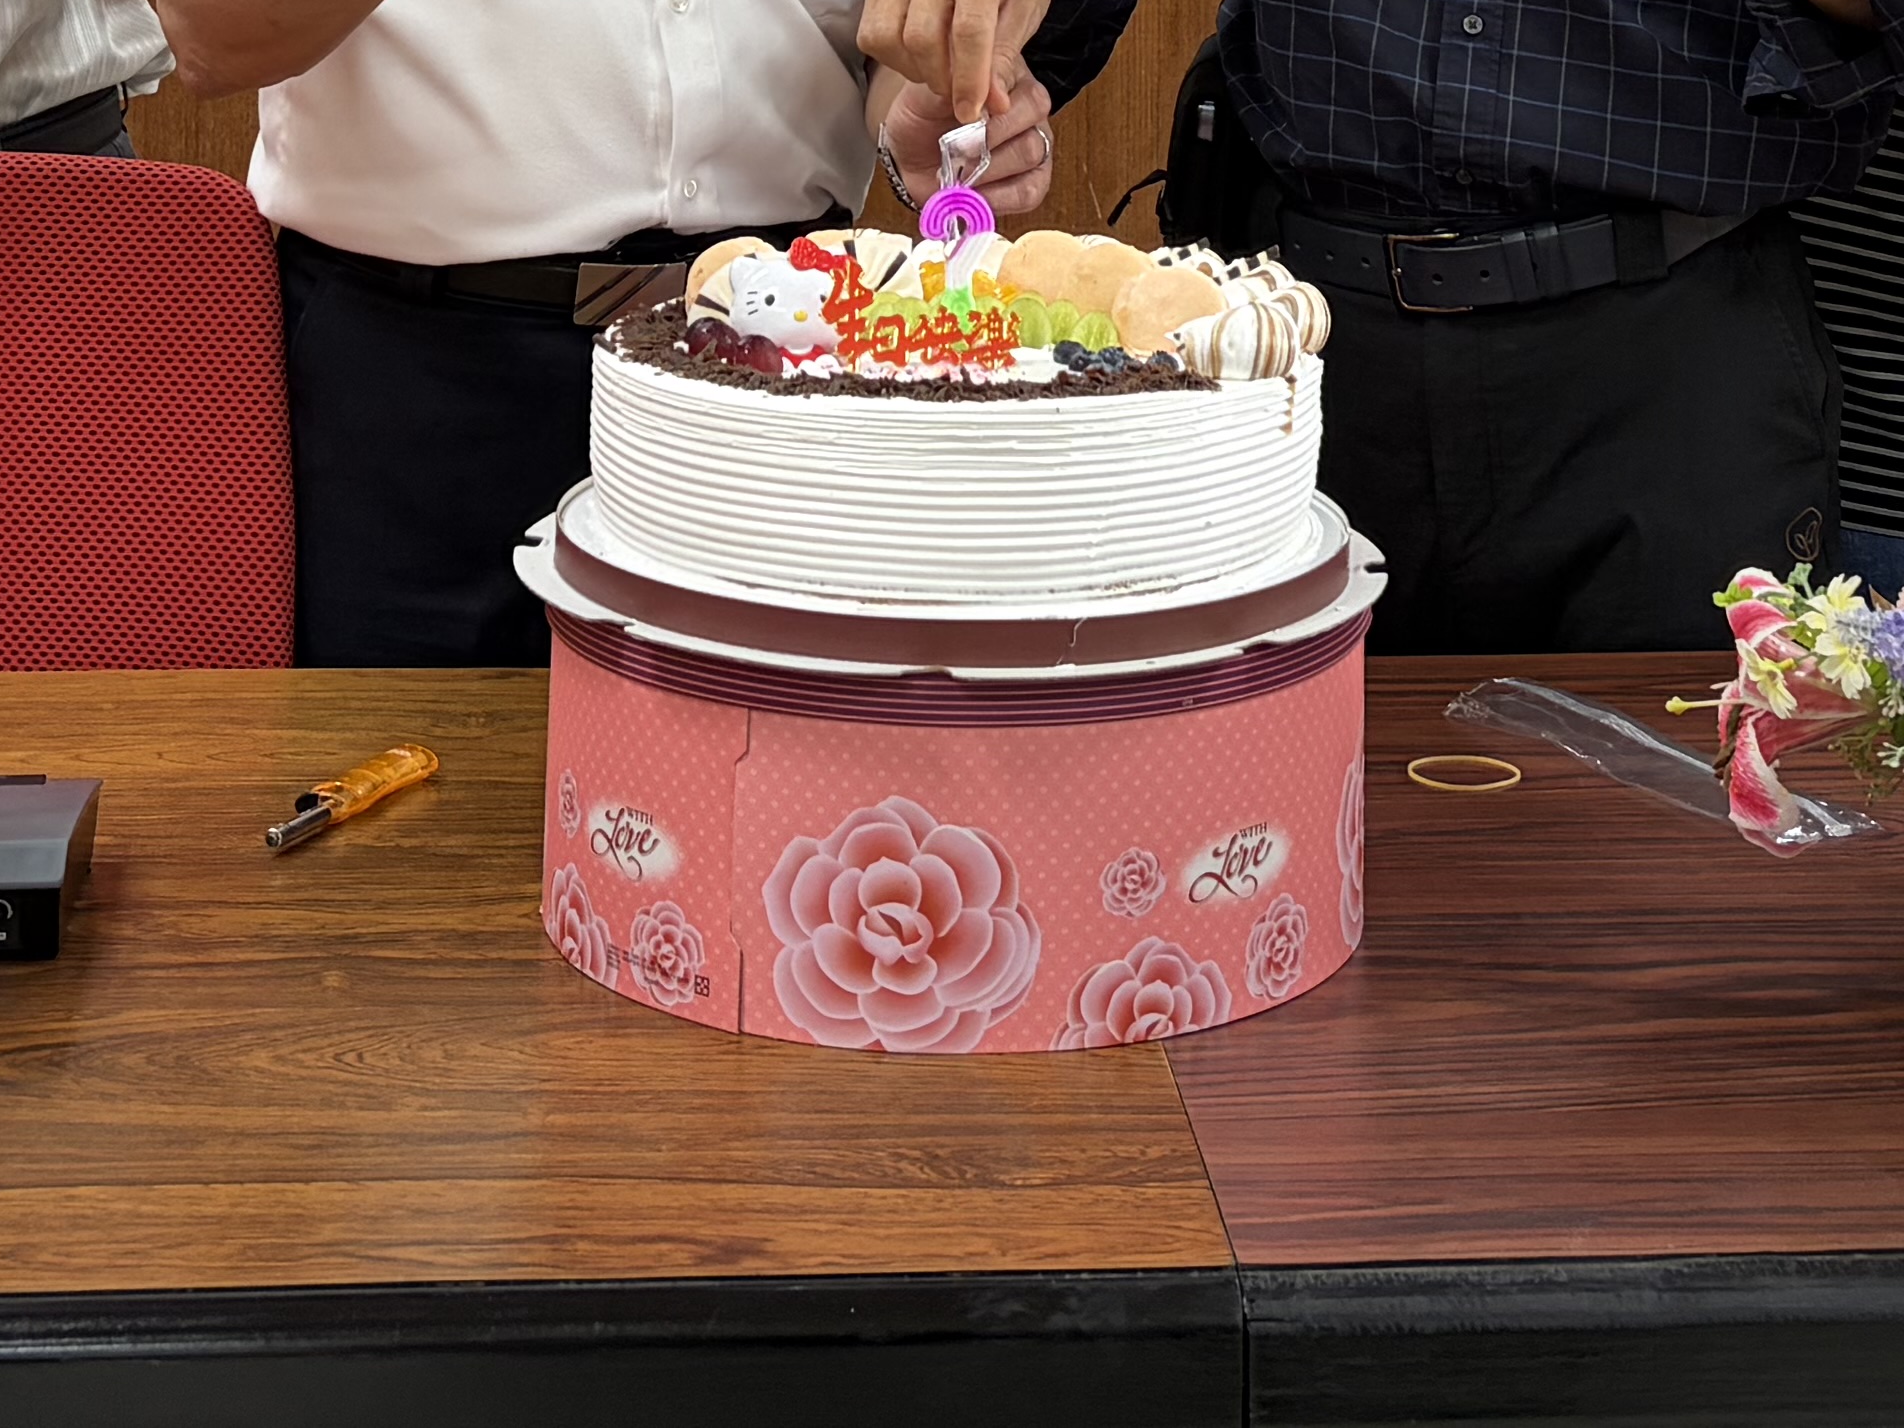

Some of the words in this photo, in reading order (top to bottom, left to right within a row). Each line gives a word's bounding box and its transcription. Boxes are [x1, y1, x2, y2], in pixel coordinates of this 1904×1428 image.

[590, 808, 660, 882] Love
[1239, 821, 1267, 839] WITH
[1188, 834, 1273, 903] Love
